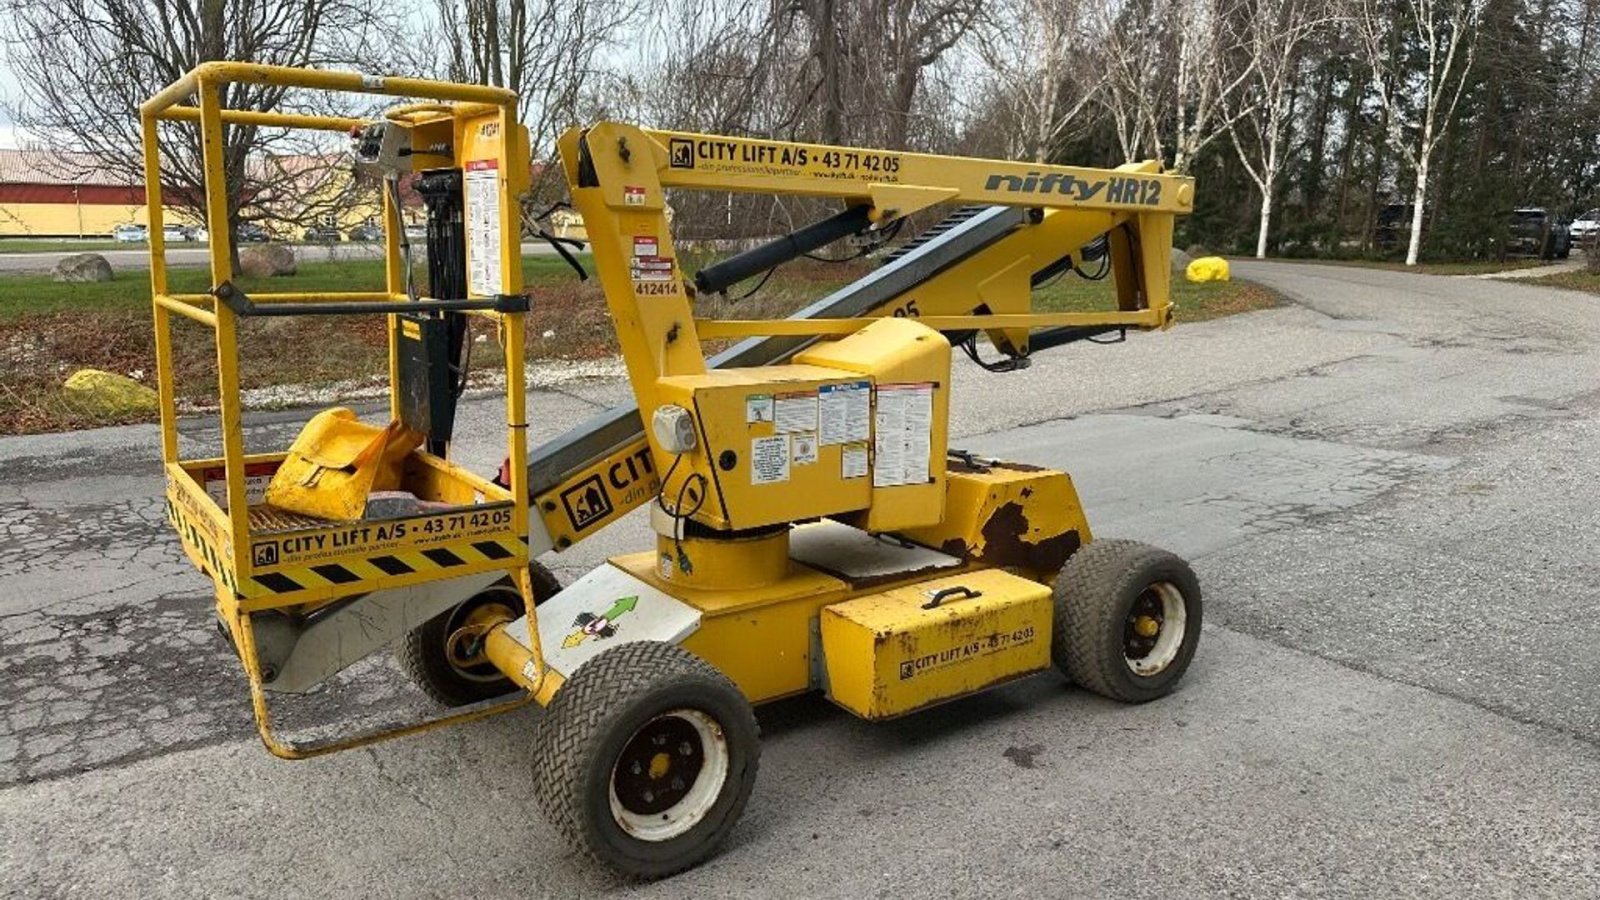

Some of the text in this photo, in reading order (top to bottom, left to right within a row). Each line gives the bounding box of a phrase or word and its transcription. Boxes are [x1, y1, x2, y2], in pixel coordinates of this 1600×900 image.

[697, 141, 899, 172] CITY LIFT A/S 43 71 42 05
[984, 172, 1162, 206] nifty HR12
[636, 282, 678, 295] 412414
[608, 445, 653, 490] CIT
[282, 534, 326, 554] CITY
[333, 527, 371, 547] LIFT
[376, 523, 406, 541] A/S
[423, 518, 444, 534] 43
[449, 516, 465, 531] 71
[470, 513, 489, 527] 42
[492, 510, 511, 525] 05
[915, 653, 938, 669] CITY
[940, 647, 961, 662] LIFT
[963, 642, 980, 657] A/S
